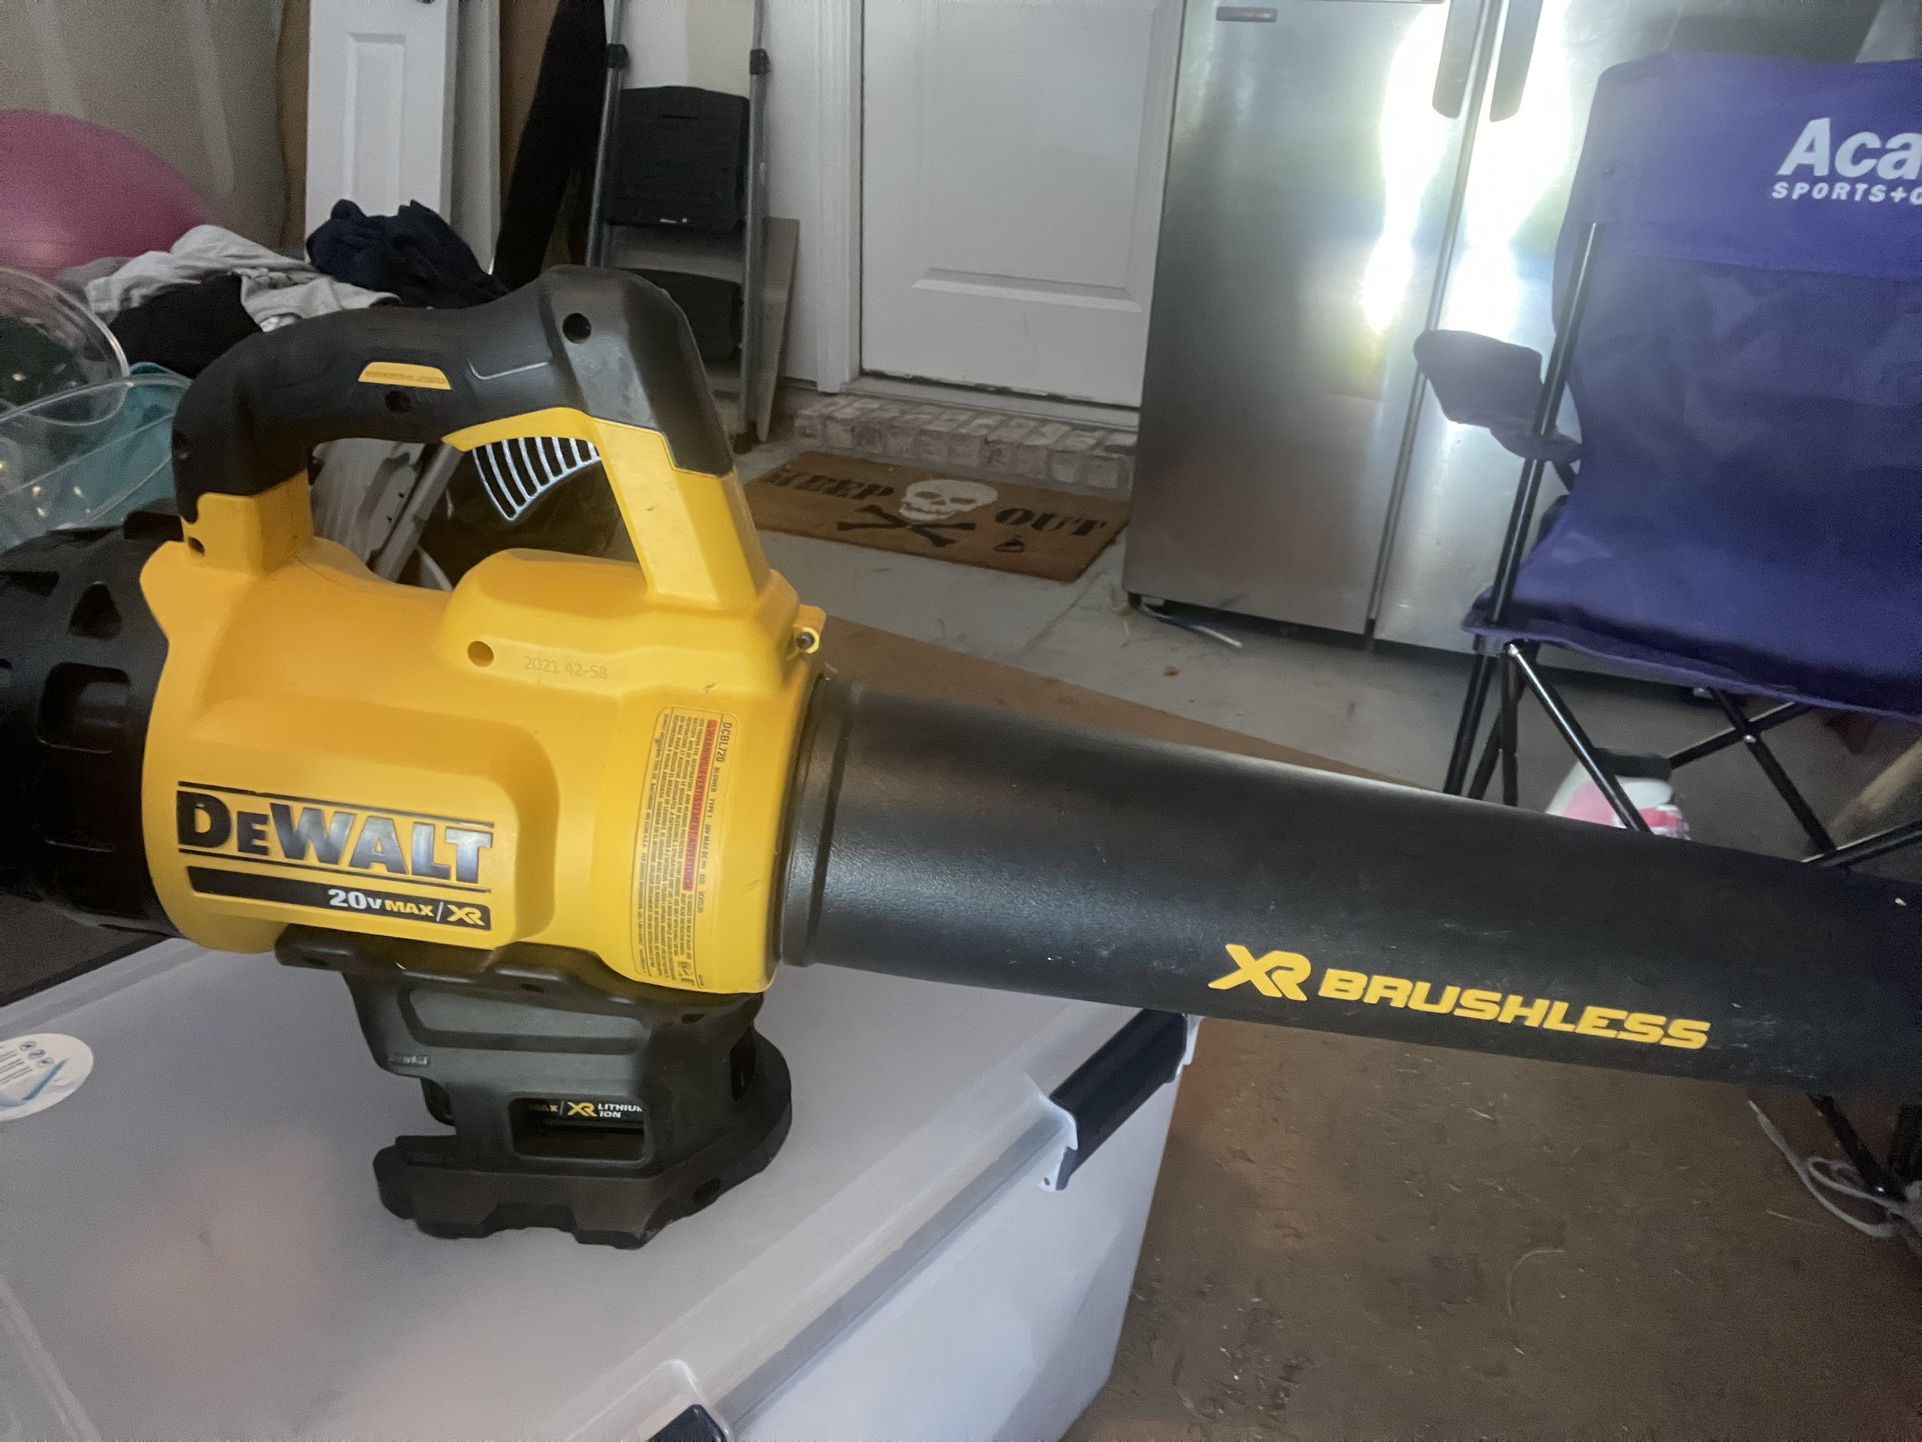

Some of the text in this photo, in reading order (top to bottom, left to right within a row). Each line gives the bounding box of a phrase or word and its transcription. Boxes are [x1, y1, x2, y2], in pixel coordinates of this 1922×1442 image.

[761, 471, 1107, 536] KEEP OUT
[523, 656, 560, 674] 2021
[715, 721, 732, 763] DCBL720
[385, 901, 435, 918] MAX
[447, 904, 486, 926] XR
[1208, 944, 1711, 1050] XR BRUSHLESS
[567, 1101, 598, 1117] XR
